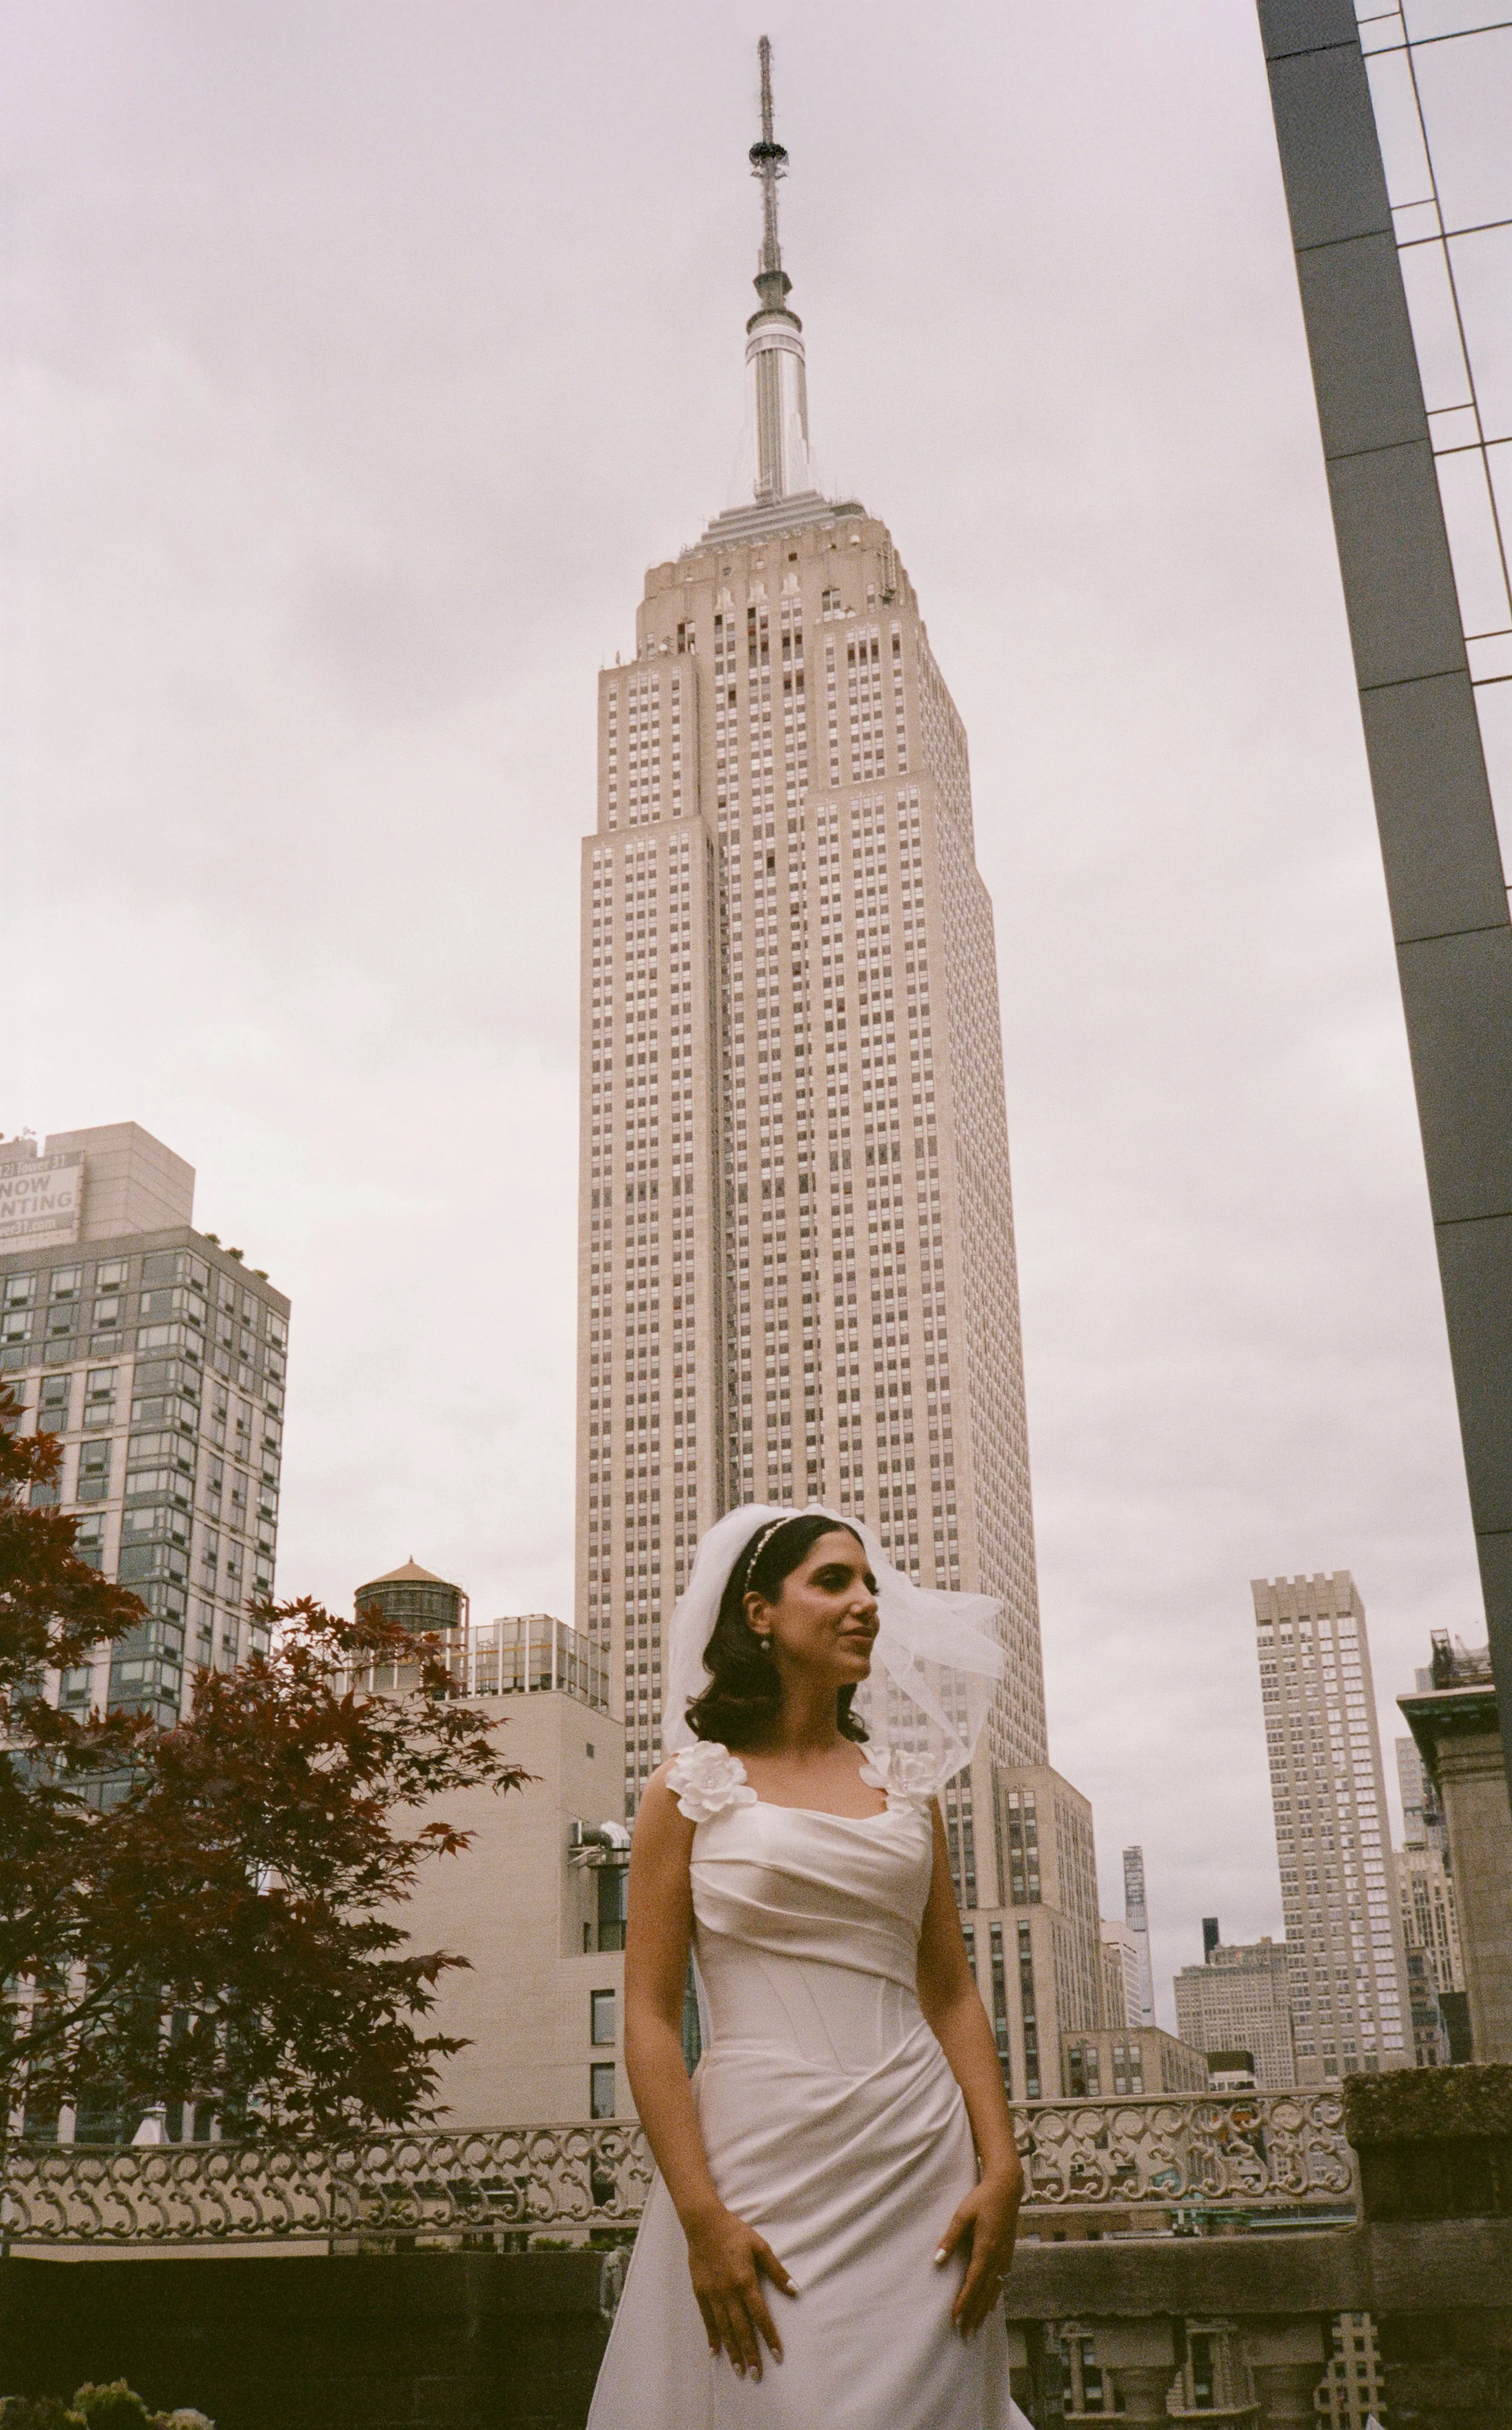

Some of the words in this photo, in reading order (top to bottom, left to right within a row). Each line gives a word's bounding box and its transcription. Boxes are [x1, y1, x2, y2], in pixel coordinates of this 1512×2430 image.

[17, 1160, 50, 1173] Tower
[52, 1155, 65, 1168] 31
[0, 1175, 51, 1199] NOW
[1, 1191, 72, 1218] NTING
